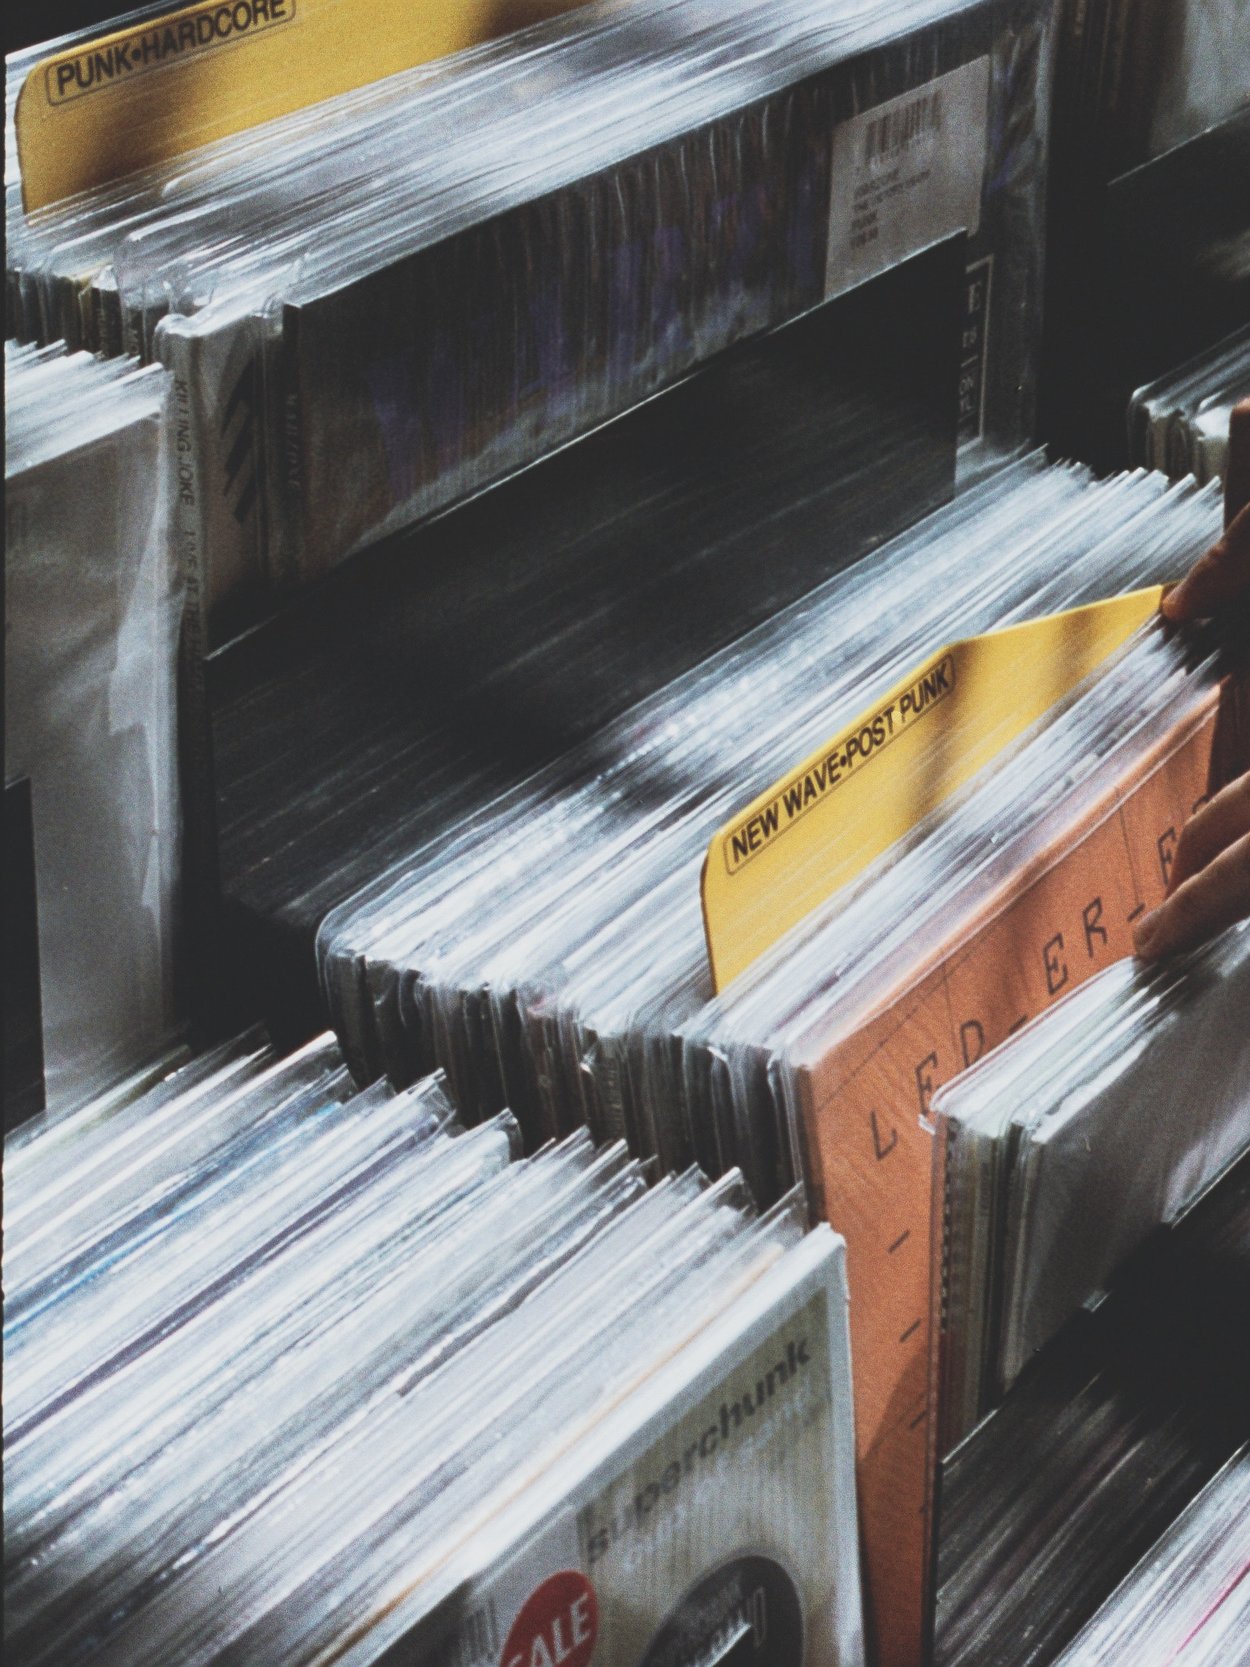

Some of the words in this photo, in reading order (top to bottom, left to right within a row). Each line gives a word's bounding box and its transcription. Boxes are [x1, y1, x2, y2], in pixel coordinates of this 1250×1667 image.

[178, 455, 195, 505] JOKE
[731, 802, 779, 864] NEW
[899, 662, 949, 724] PUNK
[509, 1591, 592, 1667] ALE
